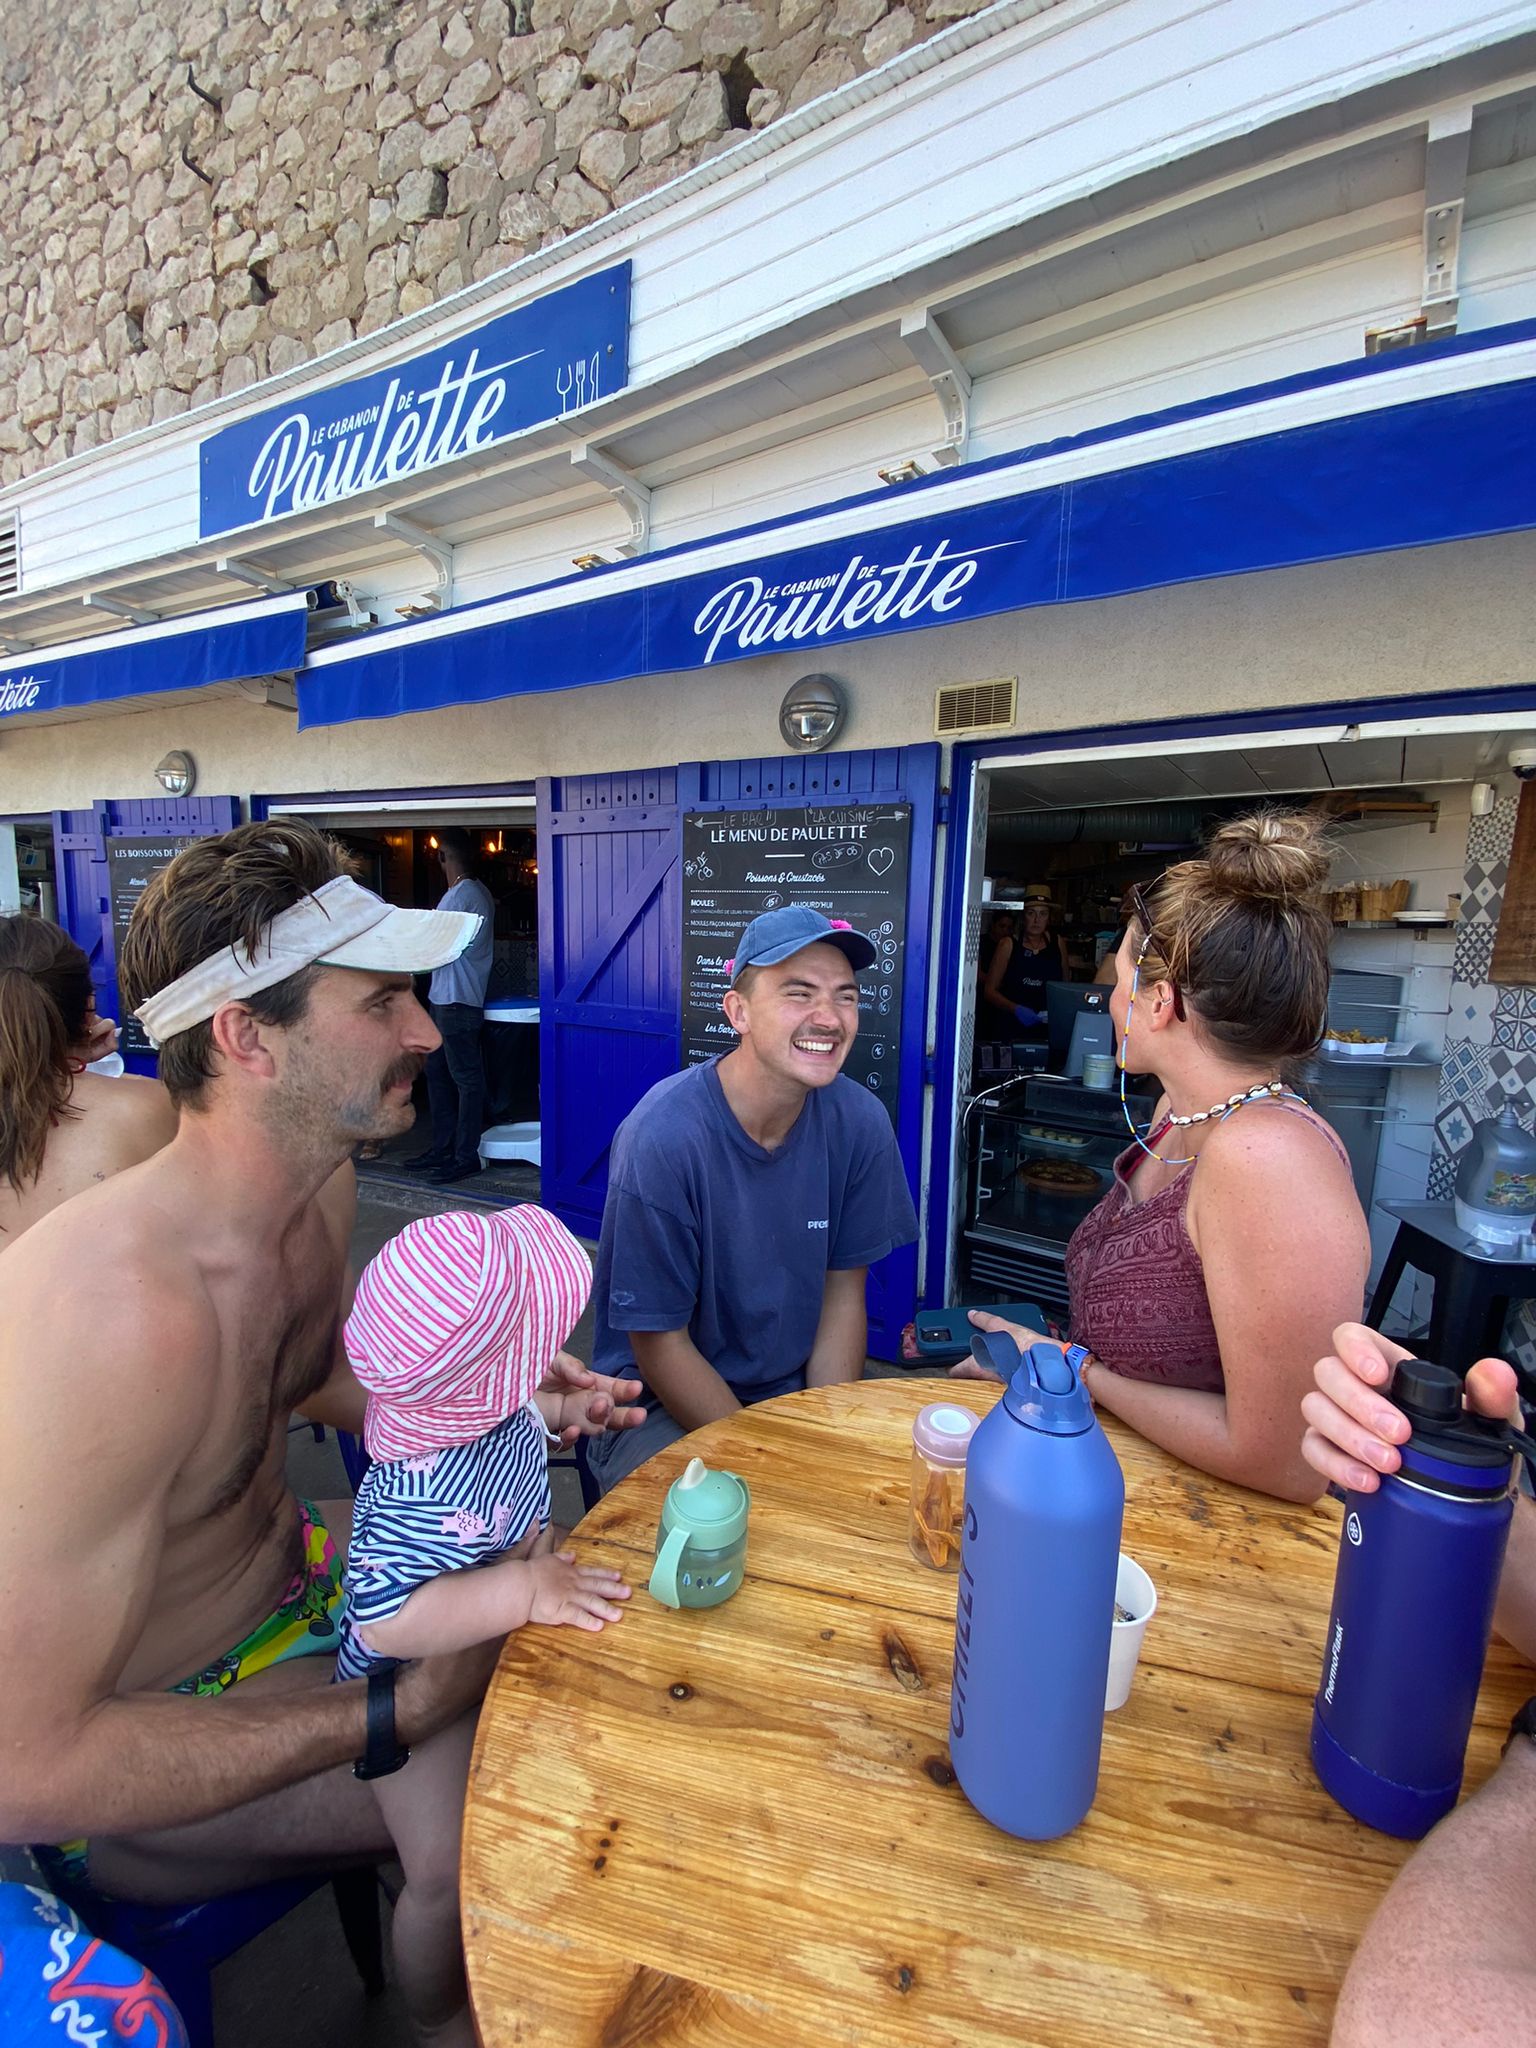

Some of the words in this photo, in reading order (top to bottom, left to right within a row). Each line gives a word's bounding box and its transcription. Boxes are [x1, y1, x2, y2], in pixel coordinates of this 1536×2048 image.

[249, 349, 545, 520] Paulette
[311, 427, 326, 446] LE
[327, 406, 379, 439] CABANON
[396, 391, 415, 413] DE
[763, 586, 779, 600] LE
[781, 573, 840, 597] CABANON
[857, 565, 879, 580] DE
[694, 539, 1027, 664] Paulette
[0, 676, 51, 711] lette
[711, 829, 727, 843] LE
[728, 828, 768, 842] MENU
[770, 827, 789, 841] DE
[791, 824, 868, 841] PAULETTE
[115, 849, 127, 858] LES
[127, 849, 163, 858] BOISSONS
[163, 848, 173, 857] DE
[745, 871, 777, 883] Poissons
[696, 955, 715, 965] Dans
[715, 956, 723, 966] le
[705, 1022, 717, 1033] Les
[1324, 1622, 1344, 1705] ThermoFlask
